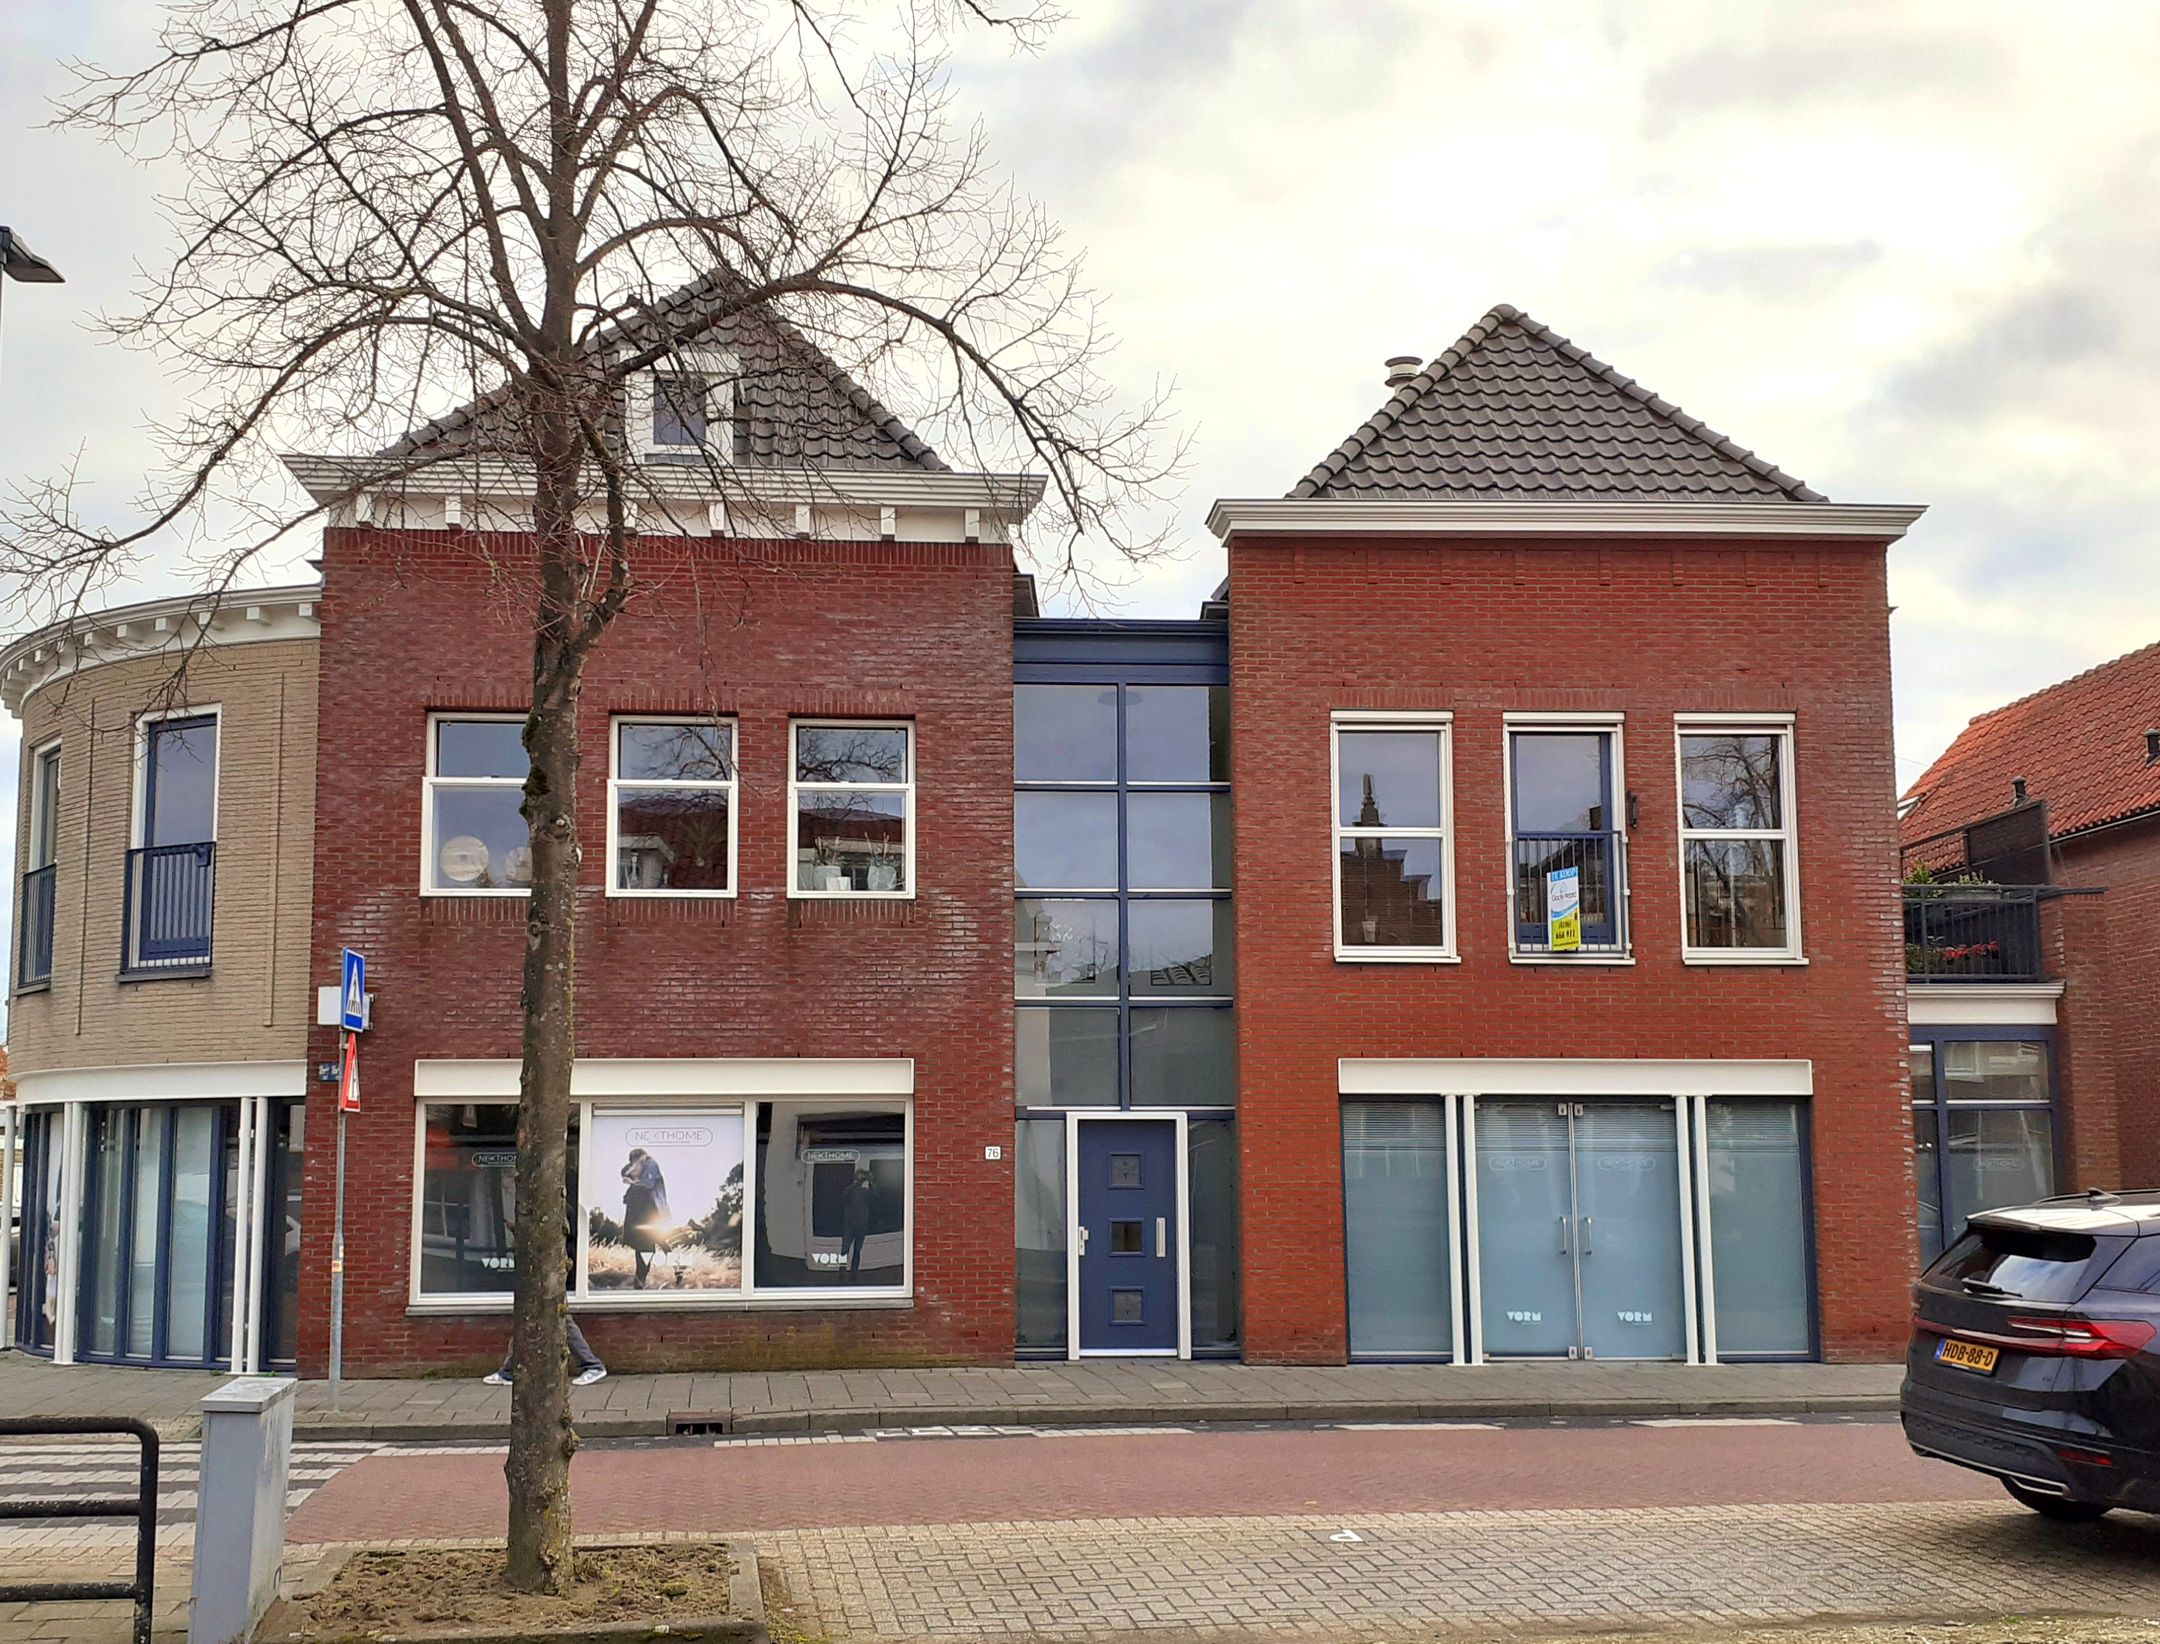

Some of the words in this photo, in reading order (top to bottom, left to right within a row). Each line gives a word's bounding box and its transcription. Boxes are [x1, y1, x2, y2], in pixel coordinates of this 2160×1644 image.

[987, 1148, 999, 1158] 76
[811, 1252, 848, 1265] VORM
[1506, 1311, 1542, 1322] VORM
[1617, 1311, 1653, 1322] VORM
[1942, 1342, 1994, 1367] HDB-88-D
